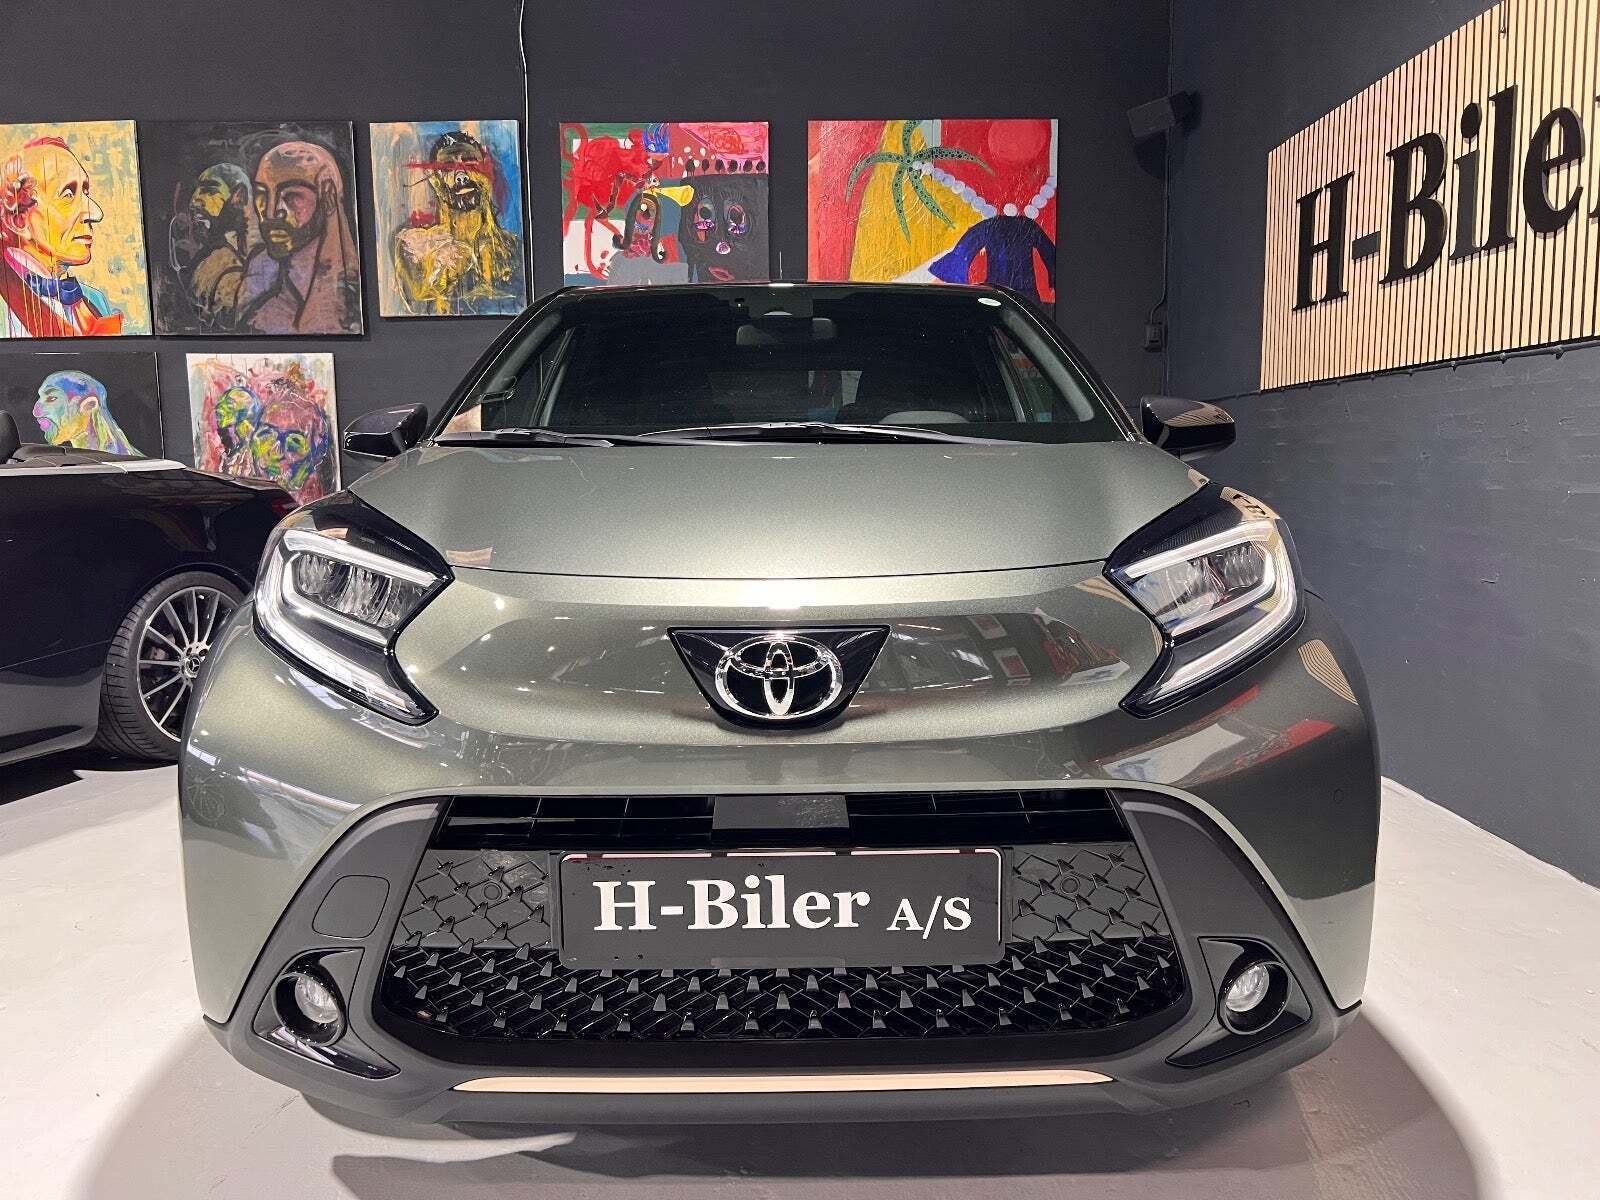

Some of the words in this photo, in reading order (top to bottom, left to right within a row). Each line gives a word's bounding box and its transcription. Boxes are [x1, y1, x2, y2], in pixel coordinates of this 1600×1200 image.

[1292, 84, 1600, 311] H-Bile
[593, 875, 871, 931] H-Biler
[886, 895, 973, 940] A/S
